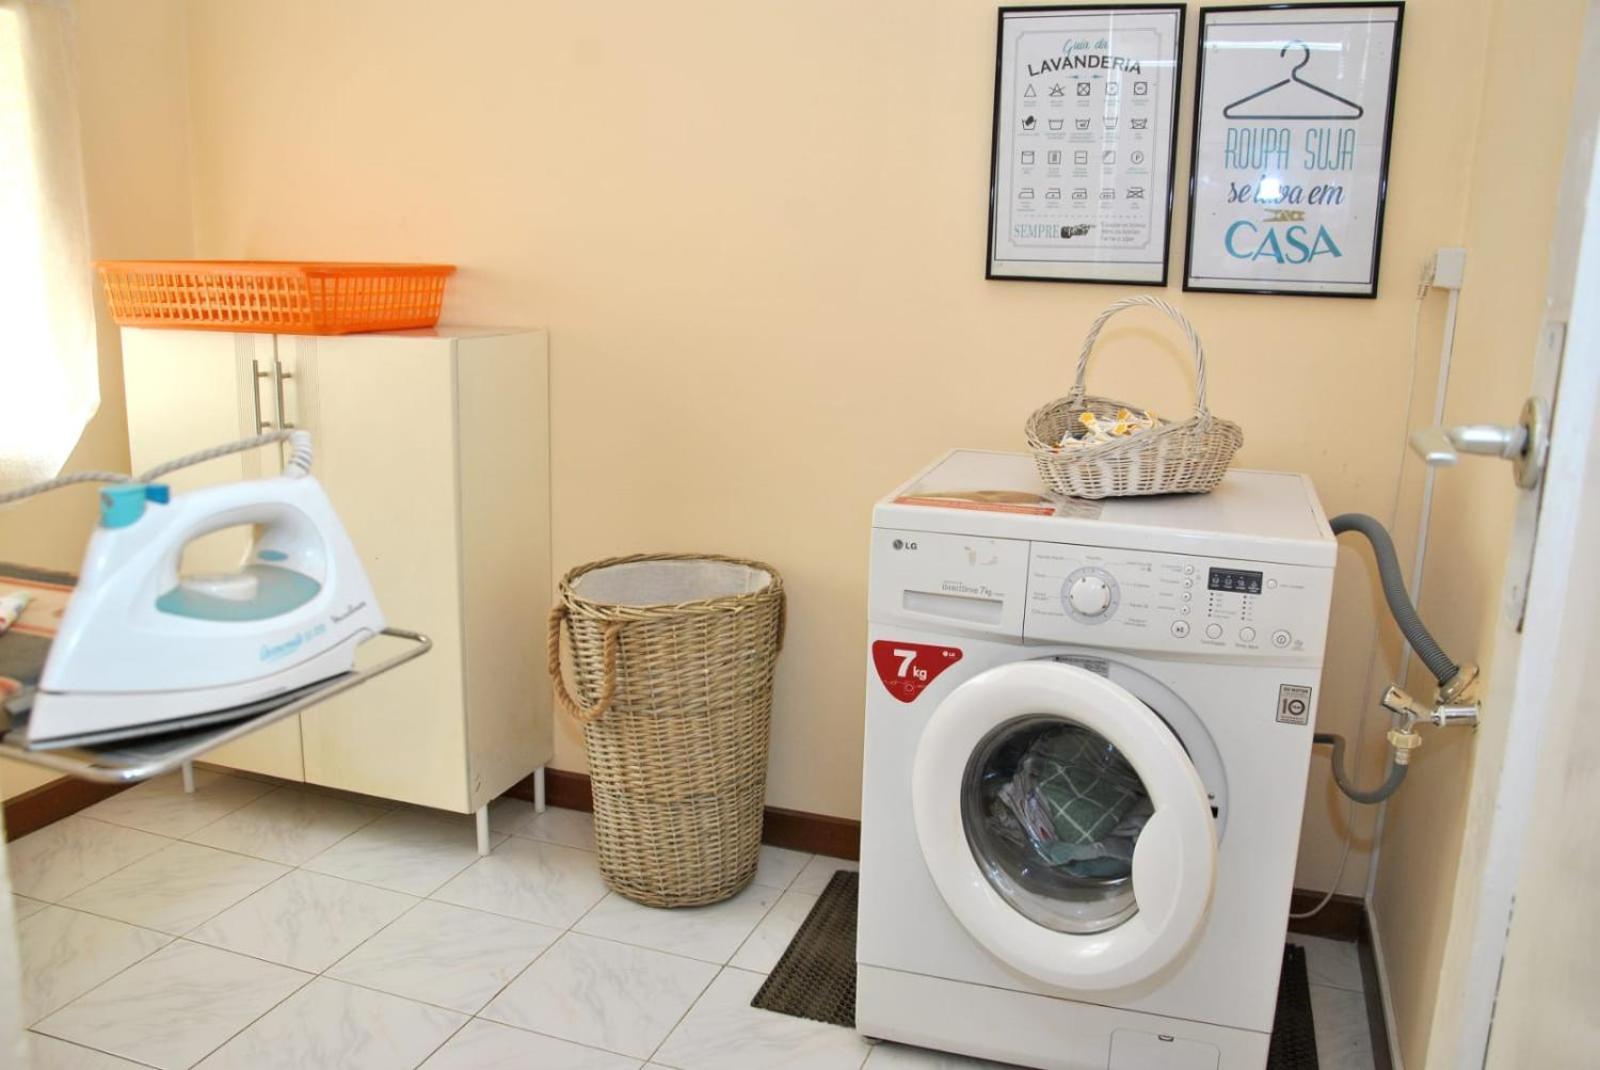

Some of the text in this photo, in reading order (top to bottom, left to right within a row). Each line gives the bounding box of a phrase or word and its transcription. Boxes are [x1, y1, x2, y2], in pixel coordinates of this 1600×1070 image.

[1063, 39, 1089, 57] Guia
[1027, 55, 1142, 77] LAVANDERIA
[1224, 127, 1357, 171] ROUPA SUJA
[1227, 181, 1252, 204] se
[1307, 184, 1345, 205] em
[1013, 223, 1060, 239] SEMPRE
[1224, 219, 1343, 264] CASA
